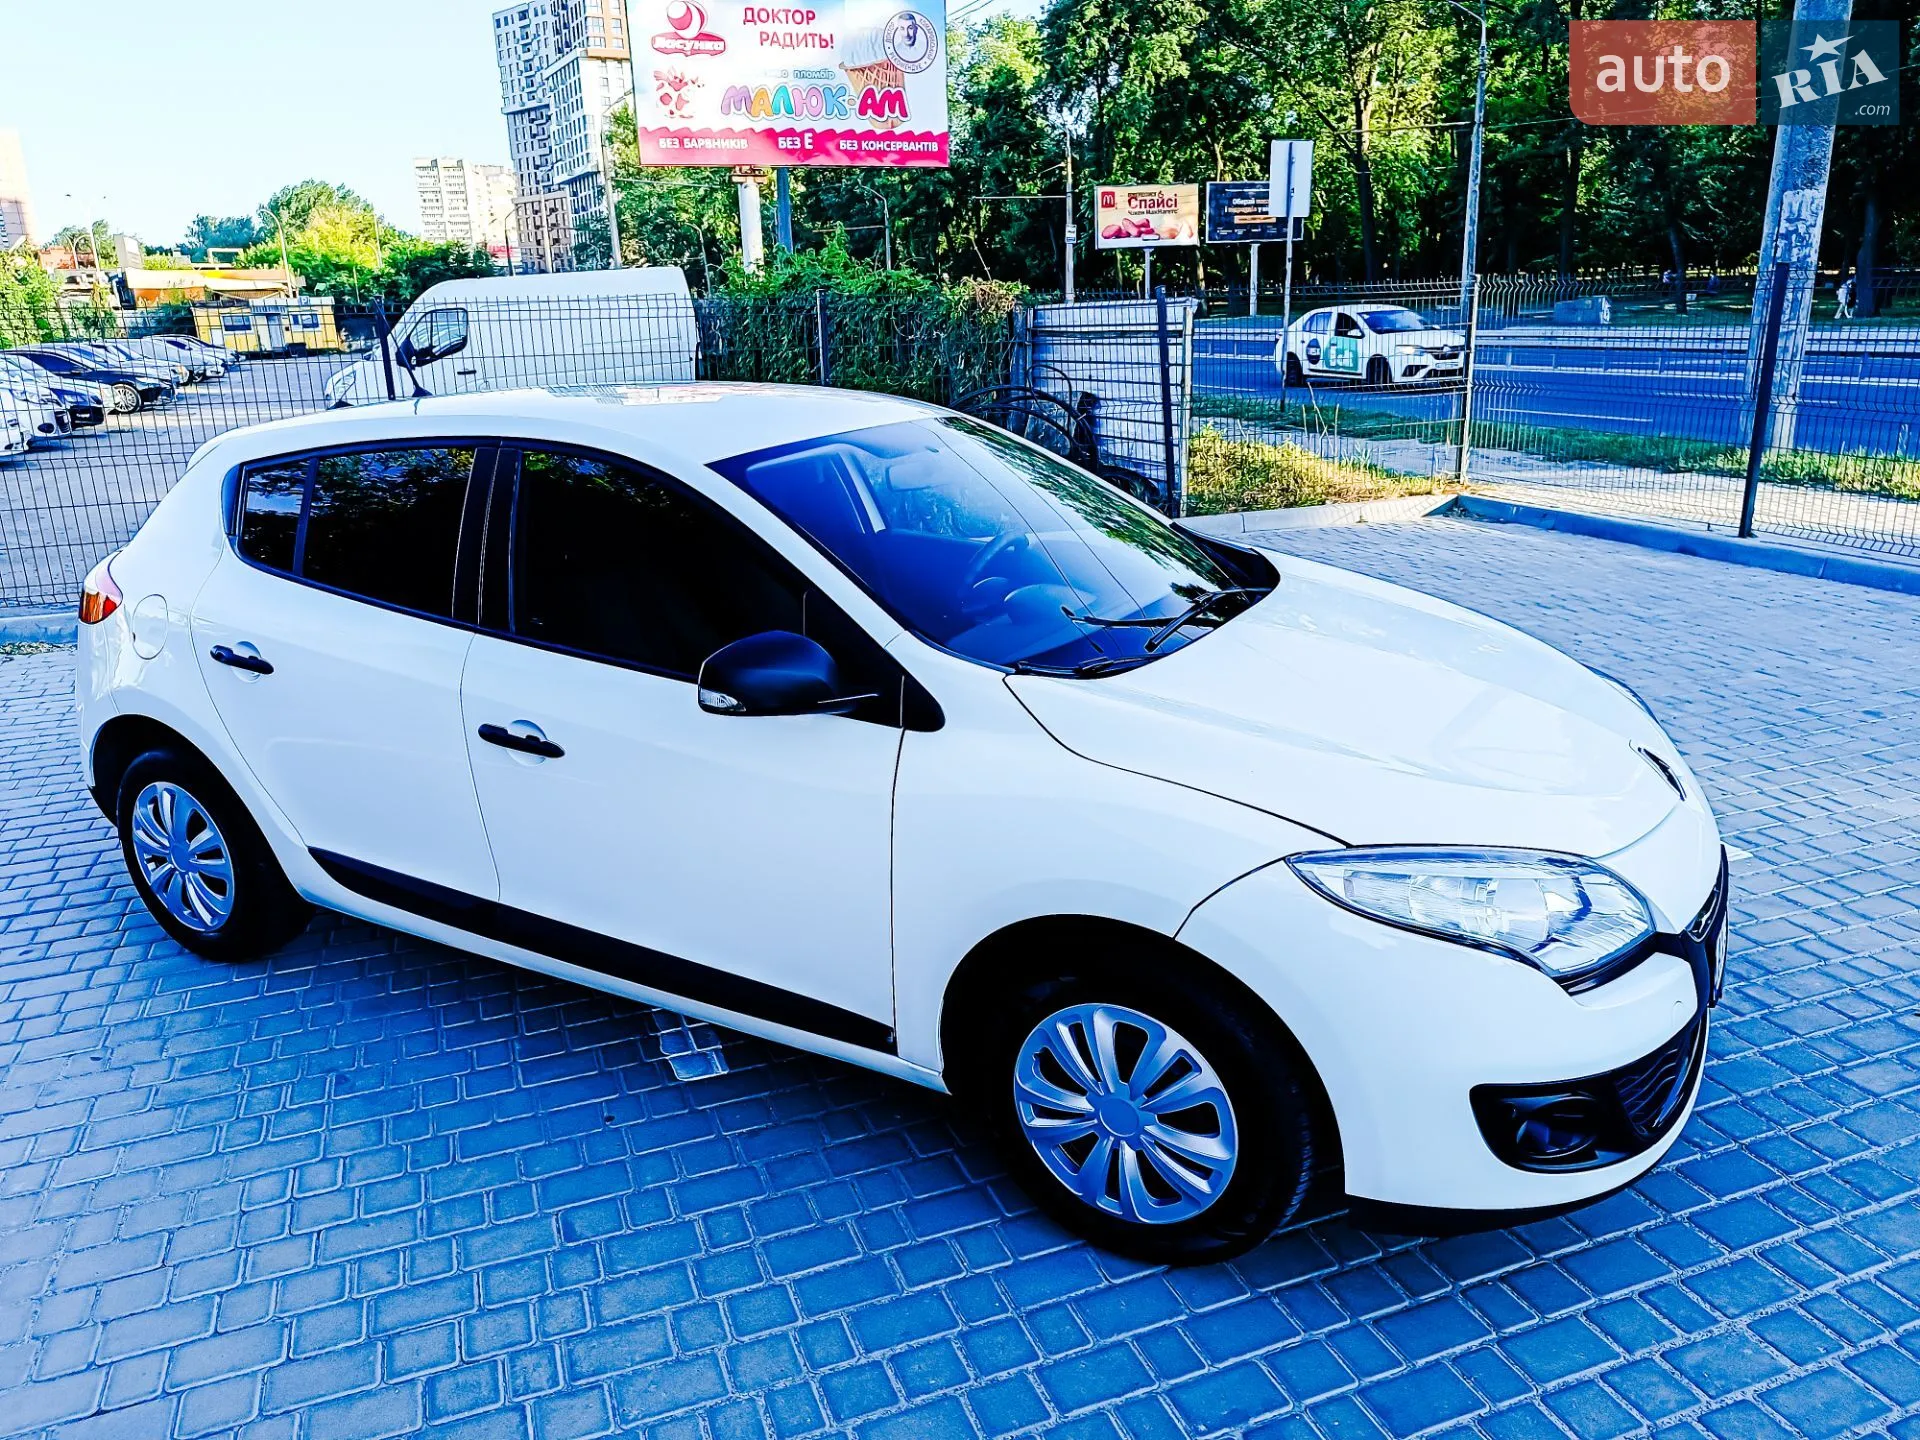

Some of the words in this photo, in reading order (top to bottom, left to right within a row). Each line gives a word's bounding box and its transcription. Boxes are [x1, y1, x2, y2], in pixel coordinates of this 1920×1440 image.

[743, 7, 816, 25] ДОКТОР
[759, 31, 834, 50] РАДИТЬ!
[659, 138, 681, 149] БЕЗ
[683, 138, 749, 150] БАРВНИКІВ
[778, 137, 801, 149] БЕЗ
[839, 139, 859, 151] БЕЗ
[861, 140, 939, 152] КОНСЕРВАНТІВ
[1128, 193, 1178, 208] Спайсі
